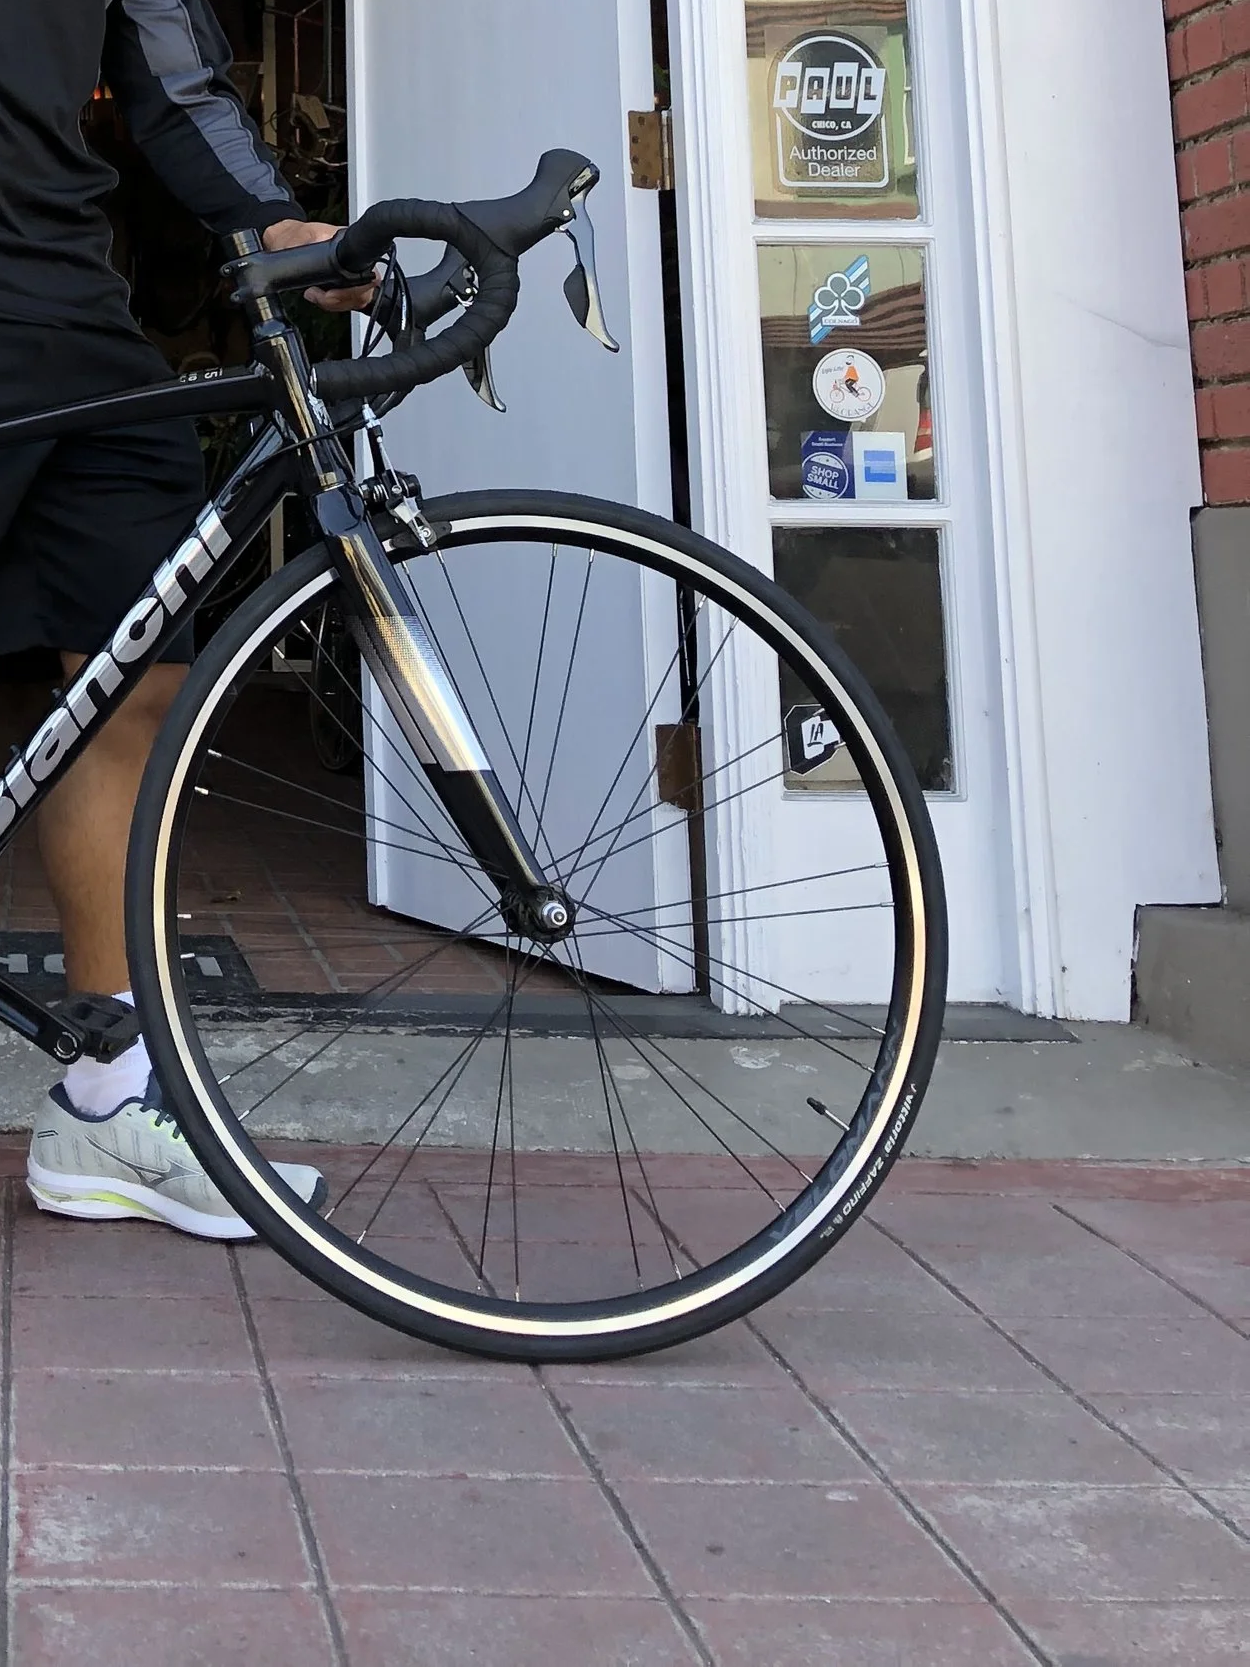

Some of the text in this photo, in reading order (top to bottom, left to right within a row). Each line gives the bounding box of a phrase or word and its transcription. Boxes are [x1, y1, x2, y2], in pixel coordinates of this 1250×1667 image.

[777, 71, 881, 106] PAUL
[811, 120, 852, 131] CHICO, CA
[789, 145, 877, 161] Authorized
[808, 162, 861, 177] Dealer
[811, 465, 840, 480] SHOP
[806, 473, 839, 490] SMALL
[842, 1094, 914, 1216] vittoria ZAFFIRO
